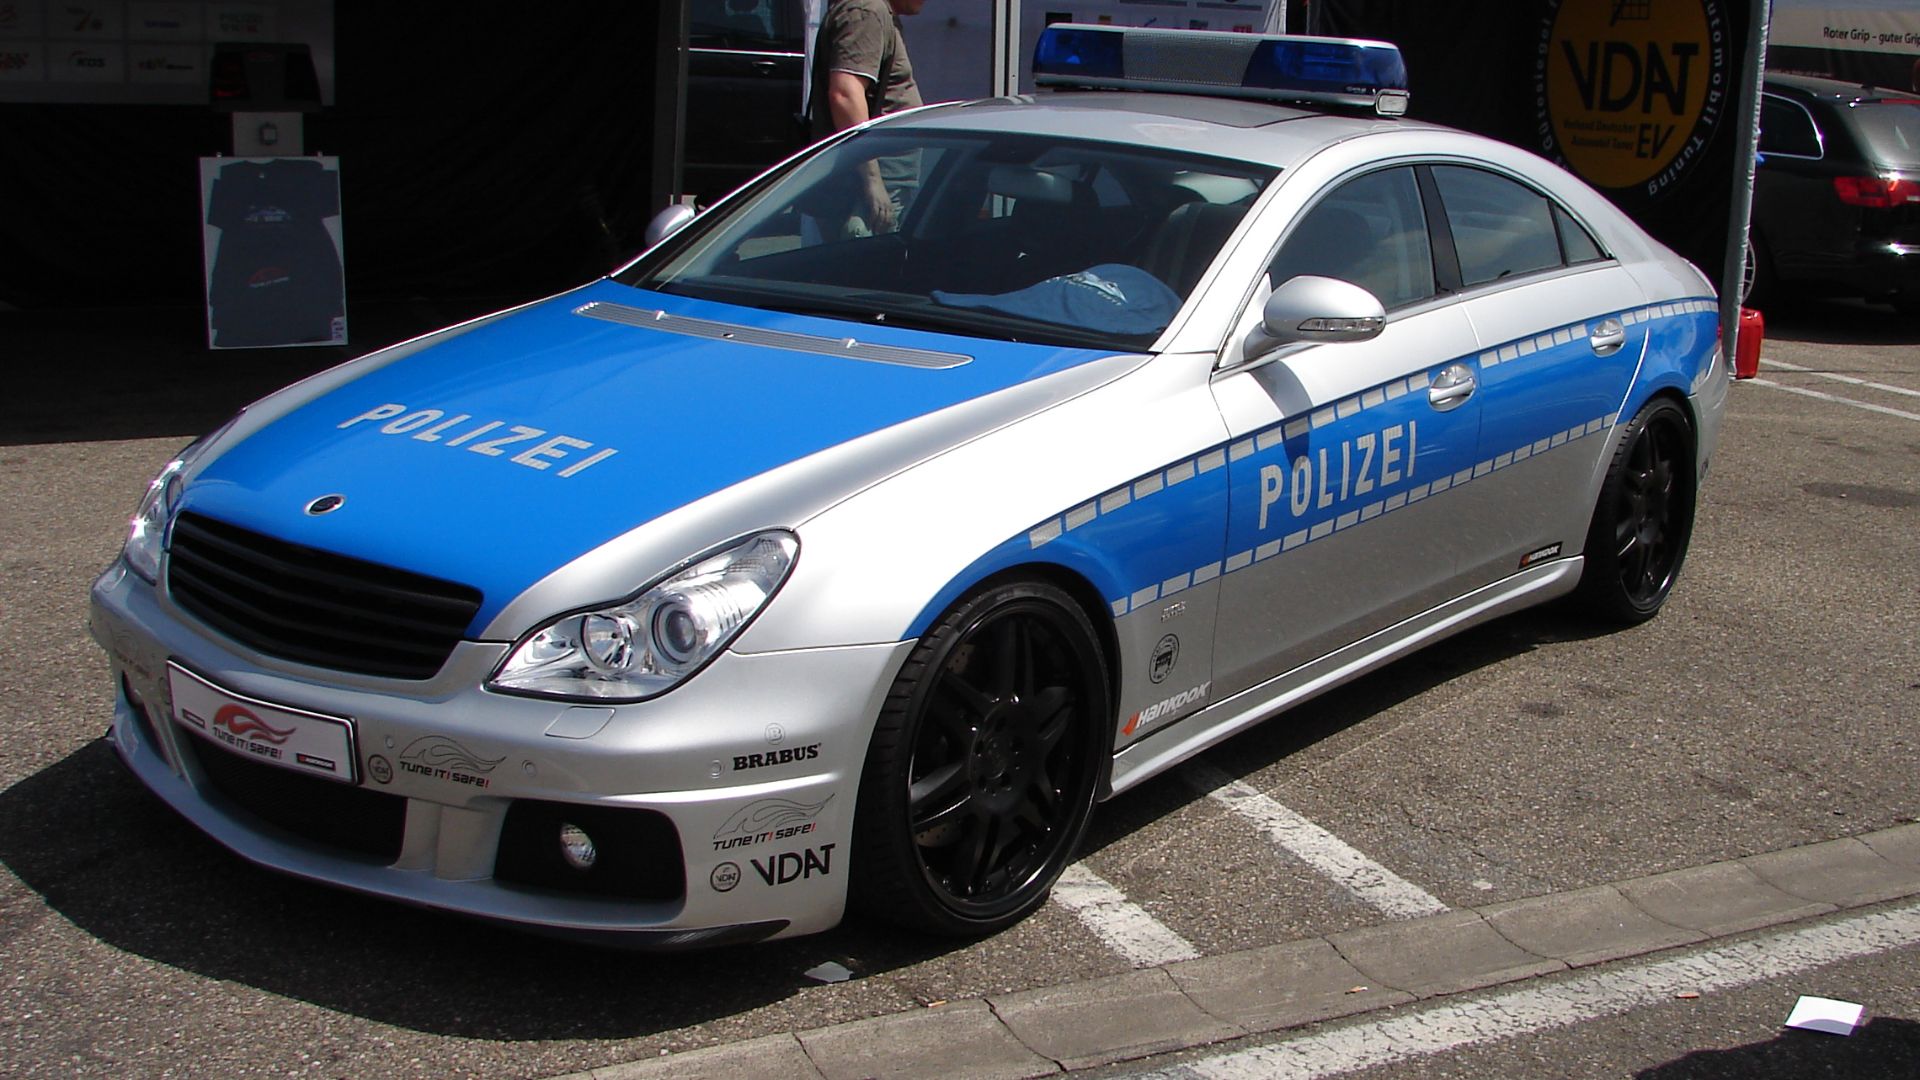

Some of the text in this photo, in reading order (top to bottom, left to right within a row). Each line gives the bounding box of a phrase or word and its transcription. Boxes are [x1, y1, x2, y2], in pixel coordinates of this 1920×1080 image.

[1702, 0, 1724, 126] utomobil
[1823, 27, 1849, 39] Roter
[1850, 29, 1870, 43] Grip
[1879, 33, 1904, 46] guter
[1562, 40, 1699, 115] VDAT
[1636, 123, 1676, 159] EV
[1647, 136, 1704, 196] Tuning
[336, 403, 620, 478] POLIZEI
[1259, 420, 1416, 530] POLIZEI
[733, 744, 820, 771] BRABUS
[750, 843, 836, 886] VDAT
